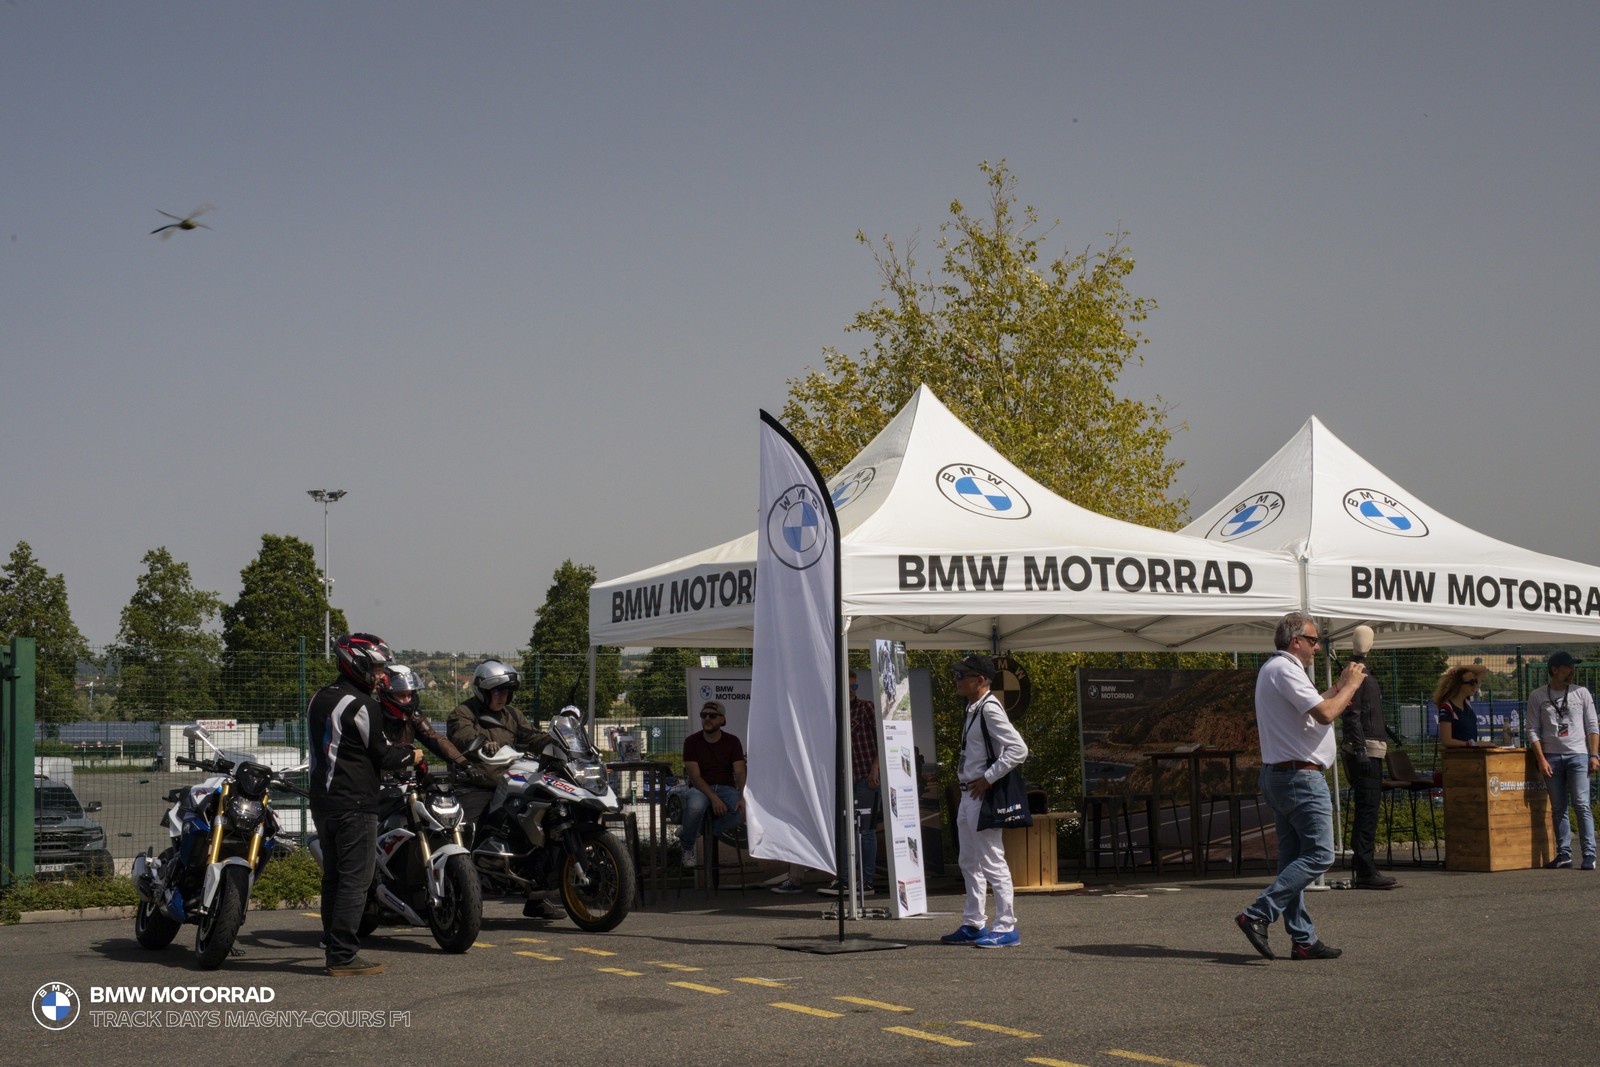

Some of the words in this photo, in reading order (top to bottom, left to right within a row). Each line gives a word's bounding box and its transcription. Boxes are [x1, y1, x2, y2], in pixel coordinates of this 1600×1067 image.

[942, 466, 1002, 486] BMW
[1235, 495, 1281, 513] BMW
[1347, 491, 1397, 507] BMW
[899, 555, 1008, 591] BMW
[1024, 556, 1253, 594] MOTORRAD
[612, 583, 664, 623] BMW
[669, 568, 757, 614] MOTOR
[1351, 566, 1436, 603] BMW
[1448, 573, 1600, 616] MOTORRA
